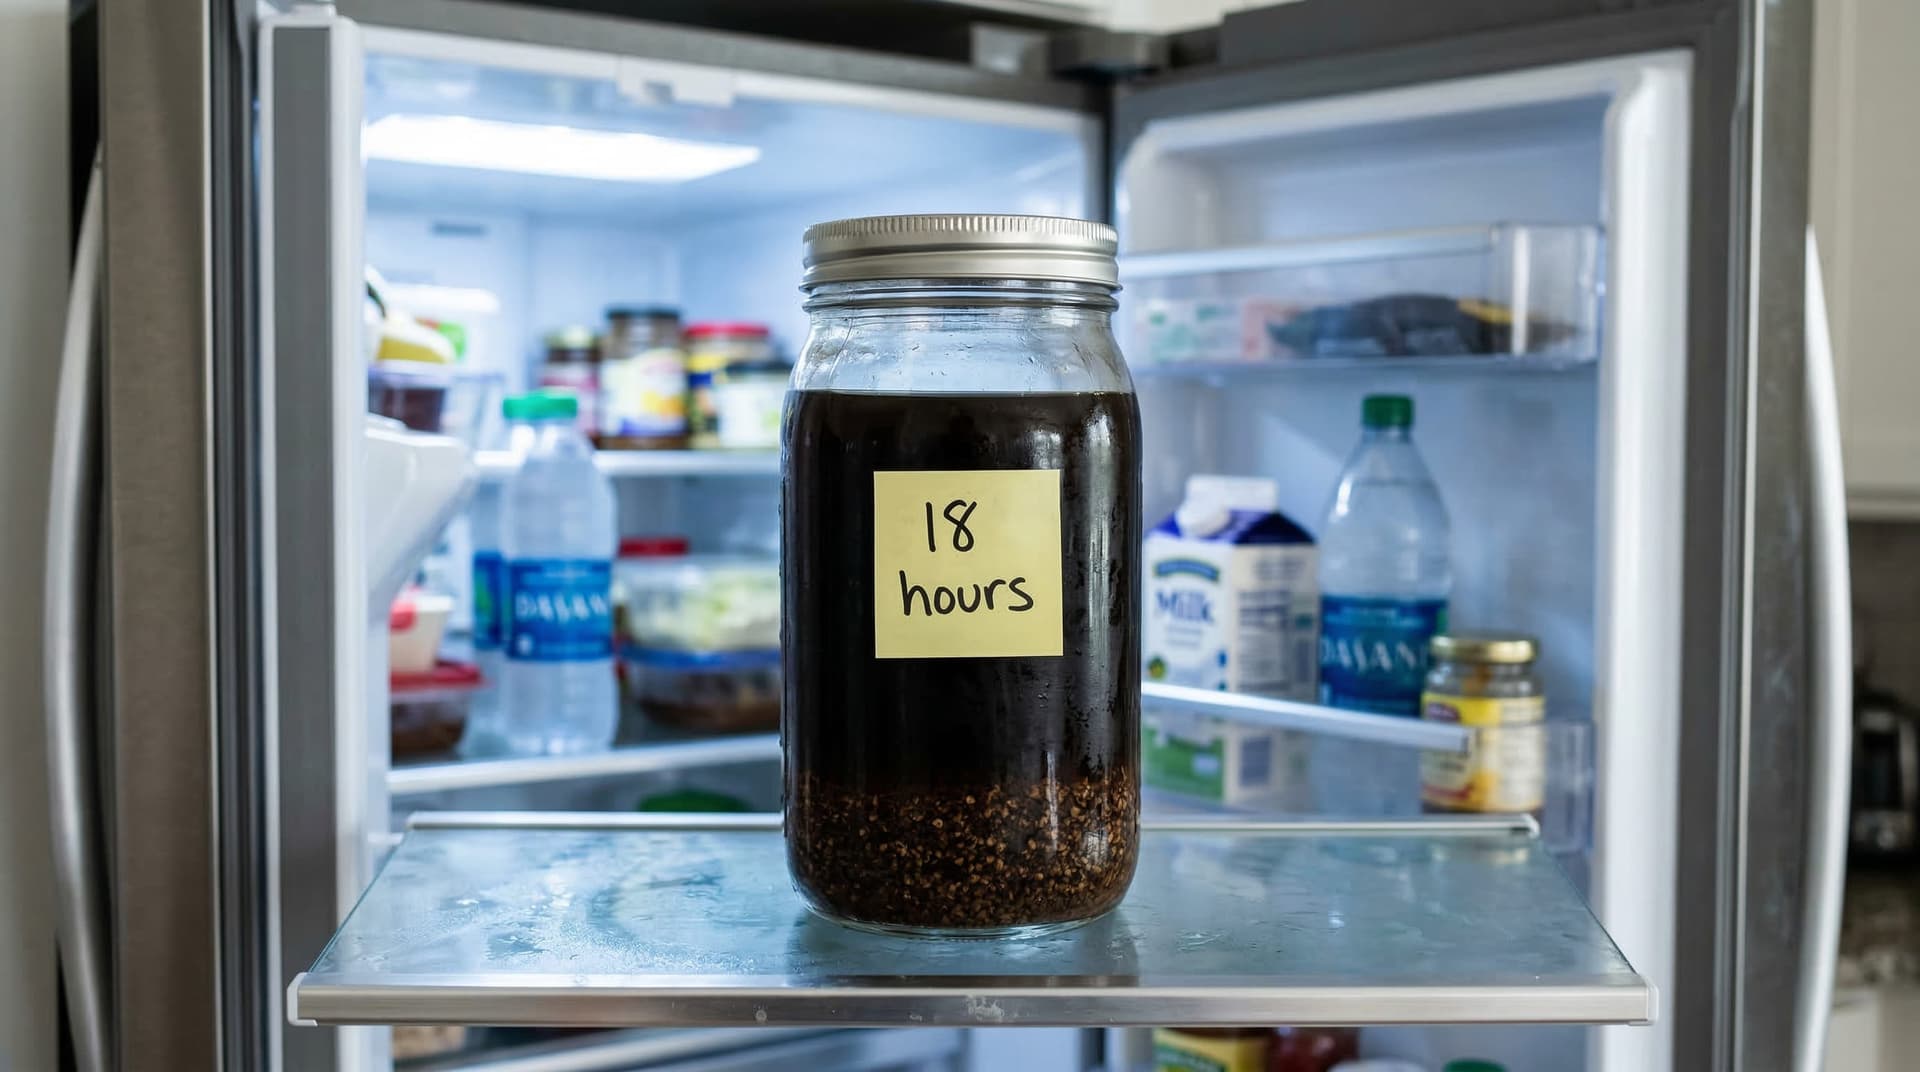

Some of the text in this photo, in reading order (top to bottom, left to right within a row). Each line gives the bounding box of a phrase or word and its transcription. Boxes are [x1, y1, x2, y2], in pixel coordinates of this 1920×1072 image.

[926, 499, 978, 553] 18
[899, 569, 1034, 617] hours
[1156, 588, 1215, 625] Milk
